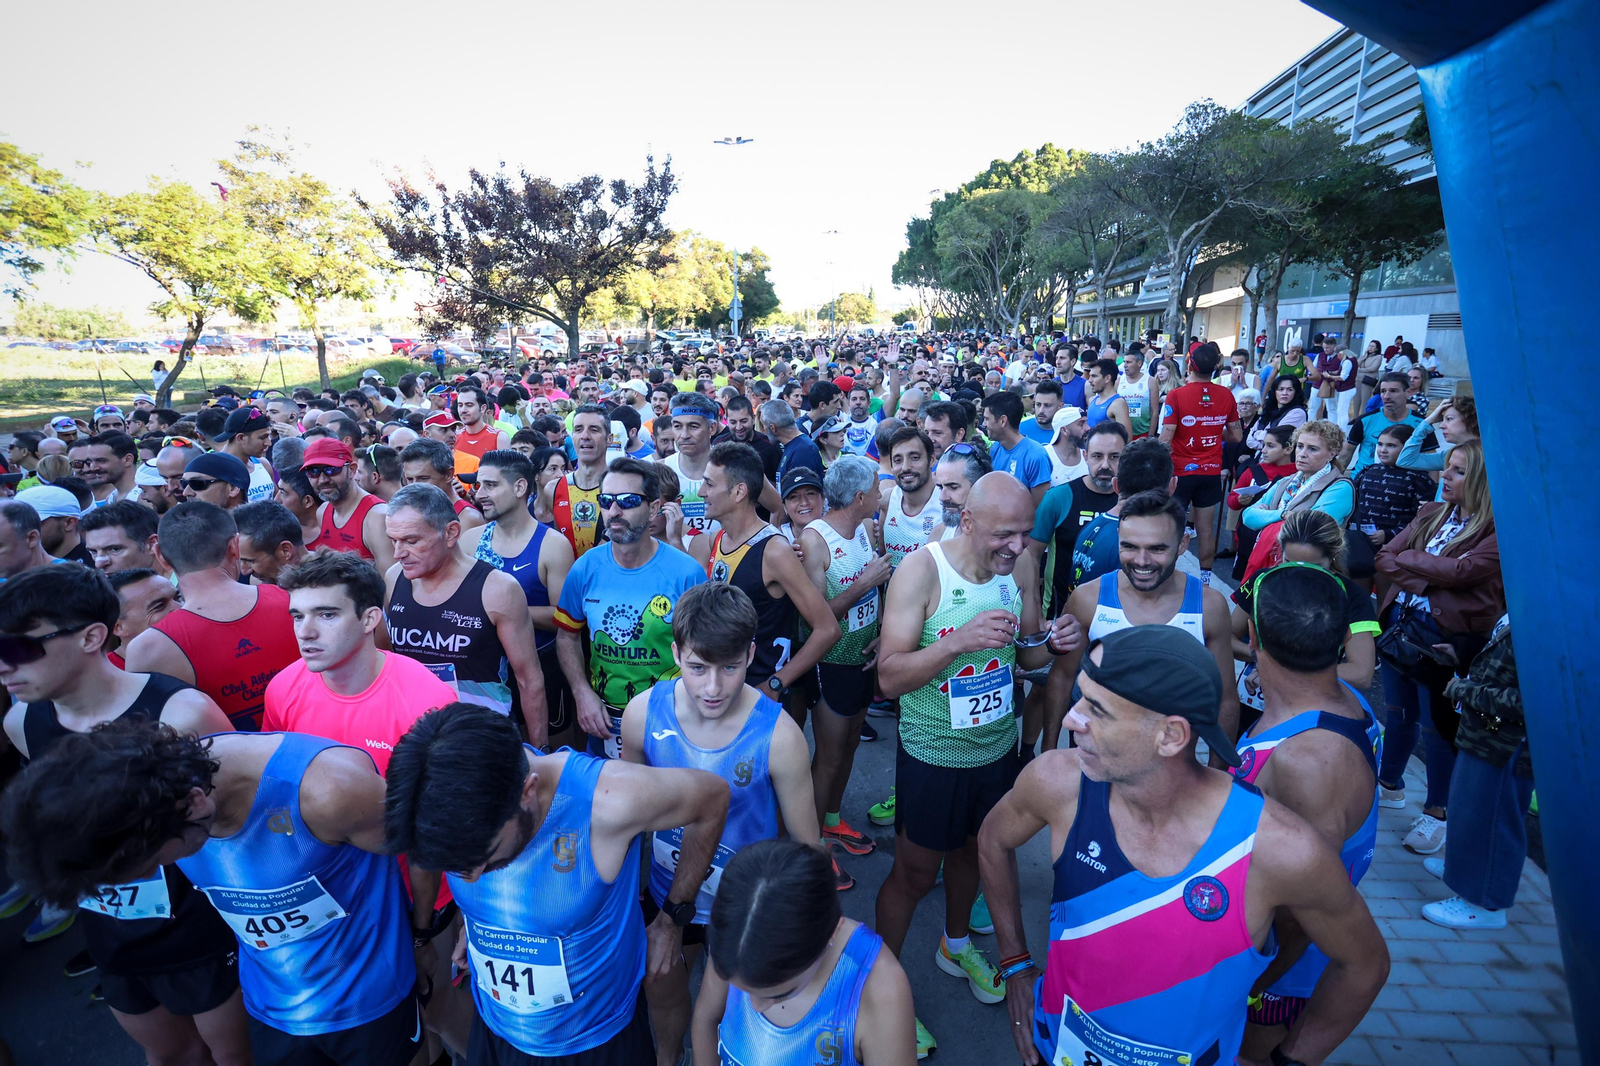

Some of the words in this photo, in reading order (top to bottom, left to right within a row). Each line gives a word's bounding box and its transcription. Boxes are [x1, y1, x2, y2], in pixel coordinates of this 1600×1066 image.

[687, 517, 714, 531] 437
[857, 600, 875, 620] 875
[973, 674, 990, 683] Carrera
[222, 680, 248, 697] Club
[969, 690, 1002, 716] 225
[1076, 851, 1107, 874] VIATOR
[238, 892, 267, 900] Carrera
[268, 884, 305, 900] Popular
[232, 900, 258, 908] Ciudad
[273, 896, 298, 907] Jerez
[245, 909, 310, 938] 405
[484, 930, 514, 940] Carrera
[516, 934, 548, 944] Popular
[478, 938, 502, 950] Ciudad
[504, 944, 515, 952] de
[516, 946, 539, 955] Jerez
[484, 960, 536, 996] 141
[1078, 1014, 1094, 1032] XLIII
[1096, 1030, 1131, 1052] Carrera
[1134, 1046, 1174, 1059] Popular
[1084, 1030, 1115, 1054] Ciudad
[1116, 1051, 1130, 1061] de
[1132, 1056, 1159, 1066] Jerez
